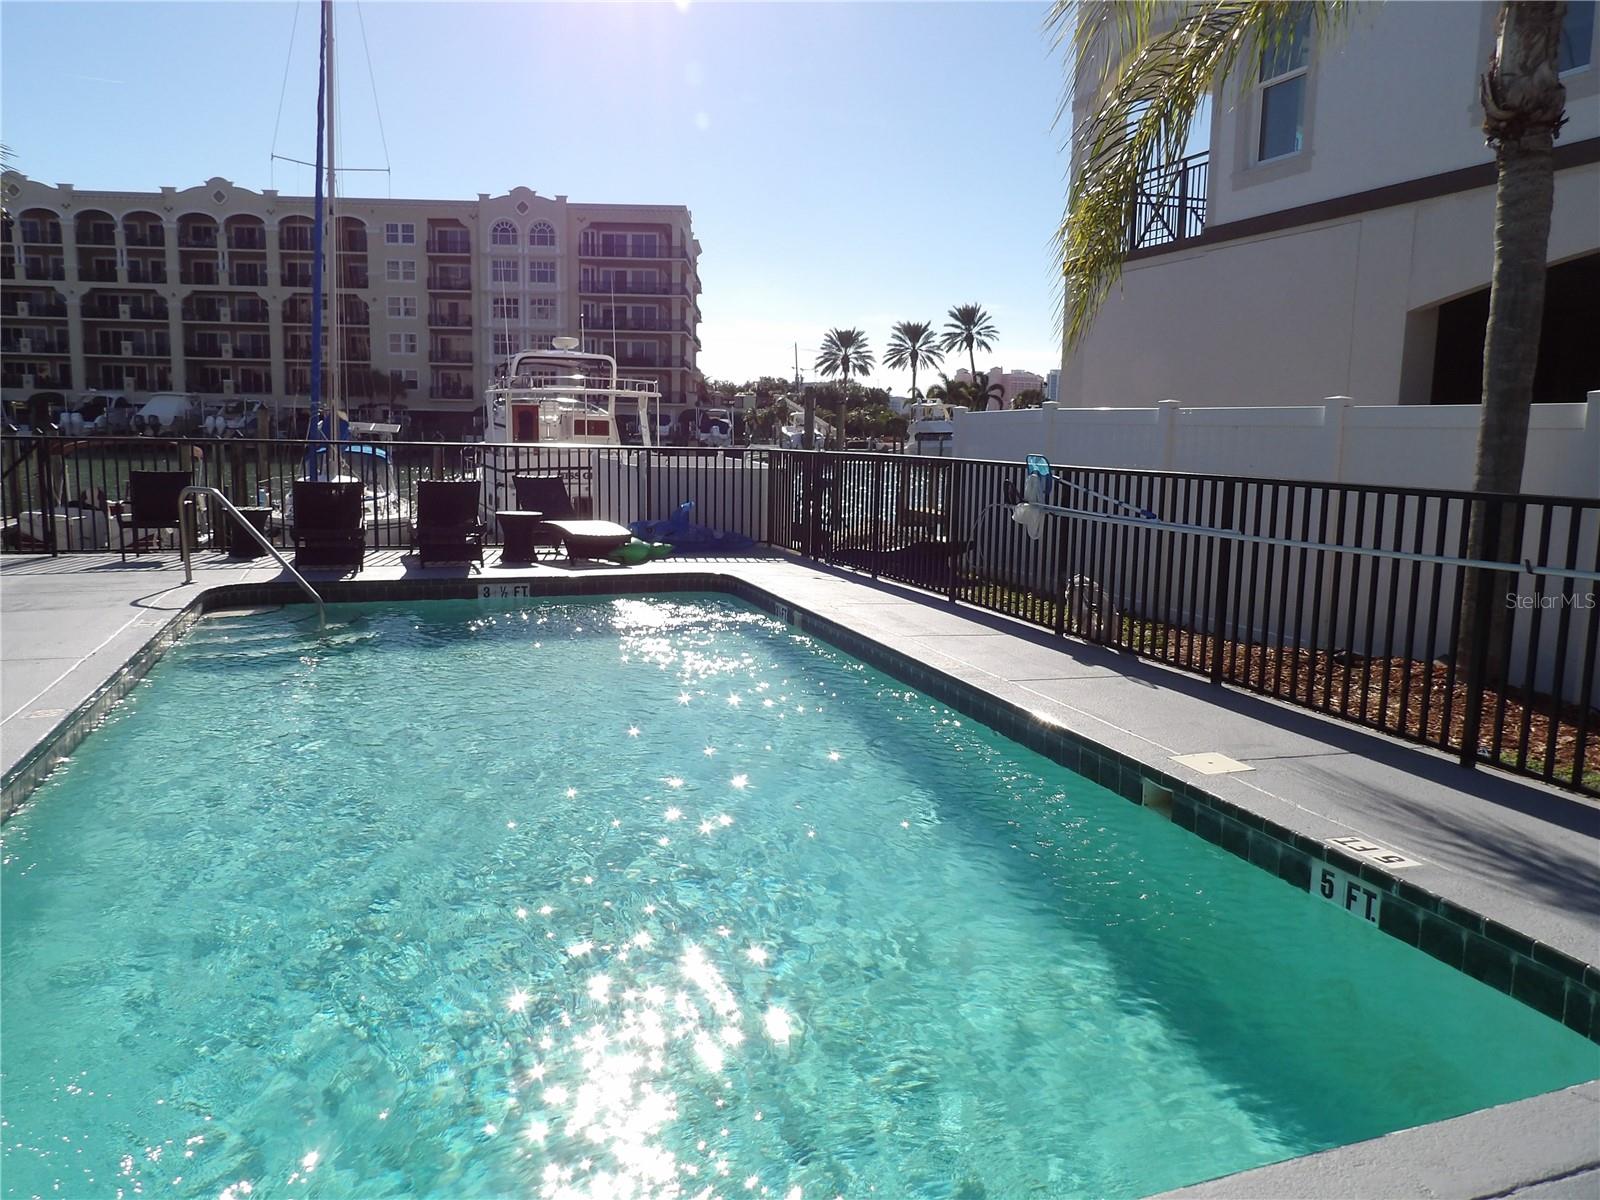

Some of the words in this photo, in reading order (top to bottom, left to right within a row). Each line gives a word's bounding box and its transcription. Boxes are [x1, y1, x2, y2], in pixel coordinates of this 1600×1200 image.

[483, 586, 490, 598] 3
[1373, 855, 1406, 864] 5
[1320, 868, 1336, 899] 5
[1345, 880, 1378, 923] FT.
